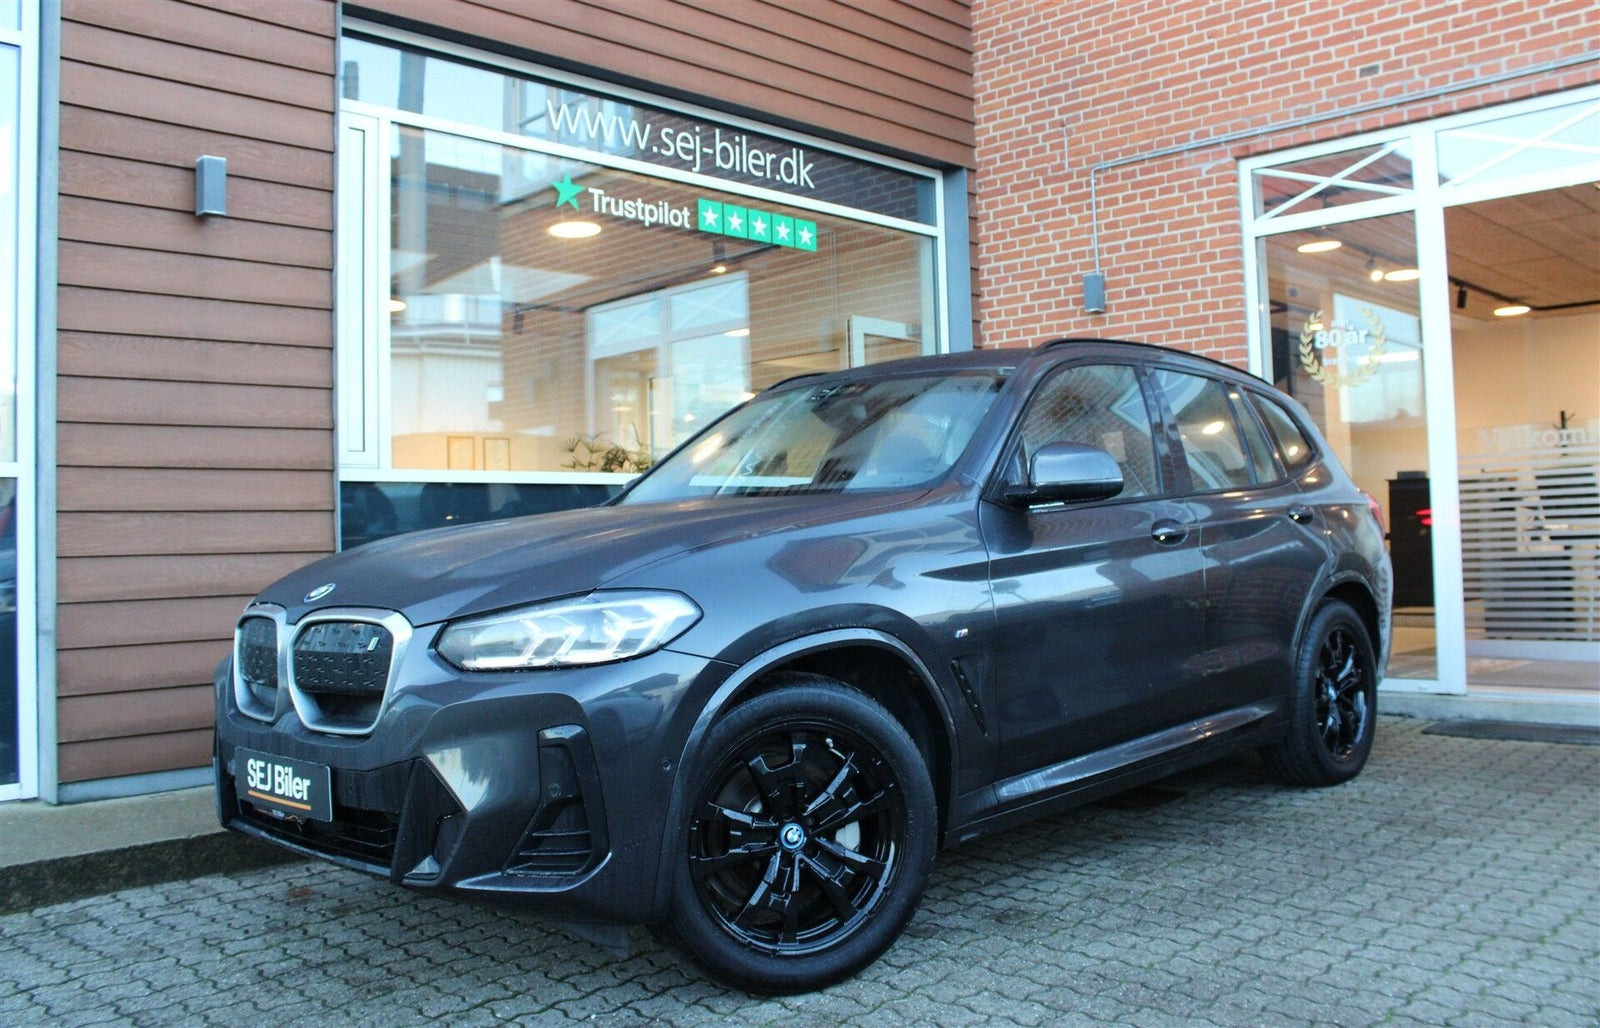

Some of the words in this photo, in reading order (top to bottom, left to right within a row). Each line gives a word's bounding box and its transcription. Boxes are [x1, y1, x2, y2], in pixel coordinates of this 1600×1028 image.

[546, 99, 815, 189] www.sej-biler.dk
[588, 187, 691, 229] Trustpilot
[1314, 329, 1341, 349] 80
[1477, 423, 1600, 453] Velkom
[247, 758, 272, 791] SEJ
[274, 764, 311, 800] Biler
